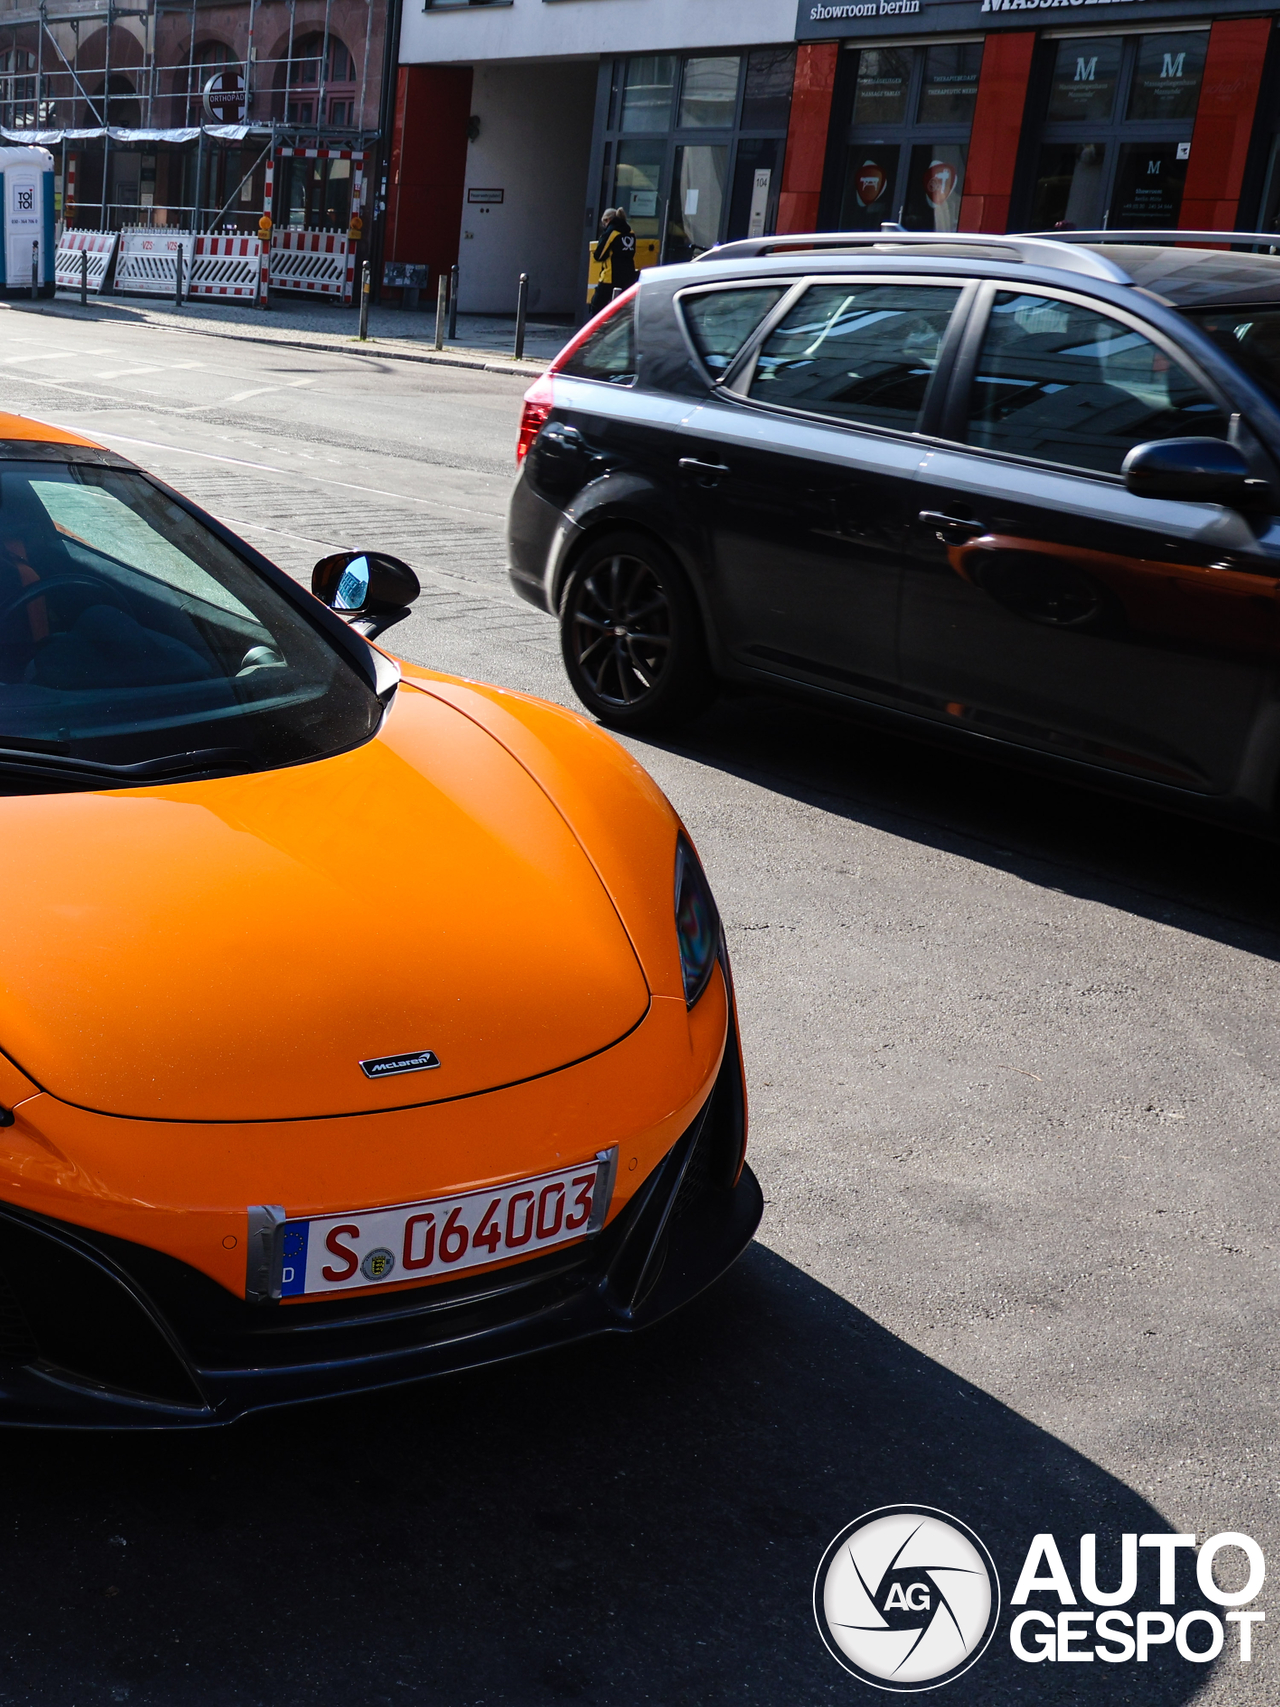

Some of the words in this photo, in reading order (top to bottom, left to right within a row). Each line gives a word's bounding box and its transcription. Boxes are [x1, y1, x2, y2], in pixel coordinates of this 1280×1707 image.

[810, 4, 876, 20] showroom
[879, 0, 919, 15] berlin
[1074, 57, 1097, 80] M
[1160, 53, 1186, 77] M
[1147, 161, 1161, 174] M
[756, 177, 767, 187] 104
[372, 1055, 429, 1072] McLaren
[322, 1224, 360, 1281] S
[402, 1173, 596, 1270] 064003
[282, 1267, 294, 1283] D
